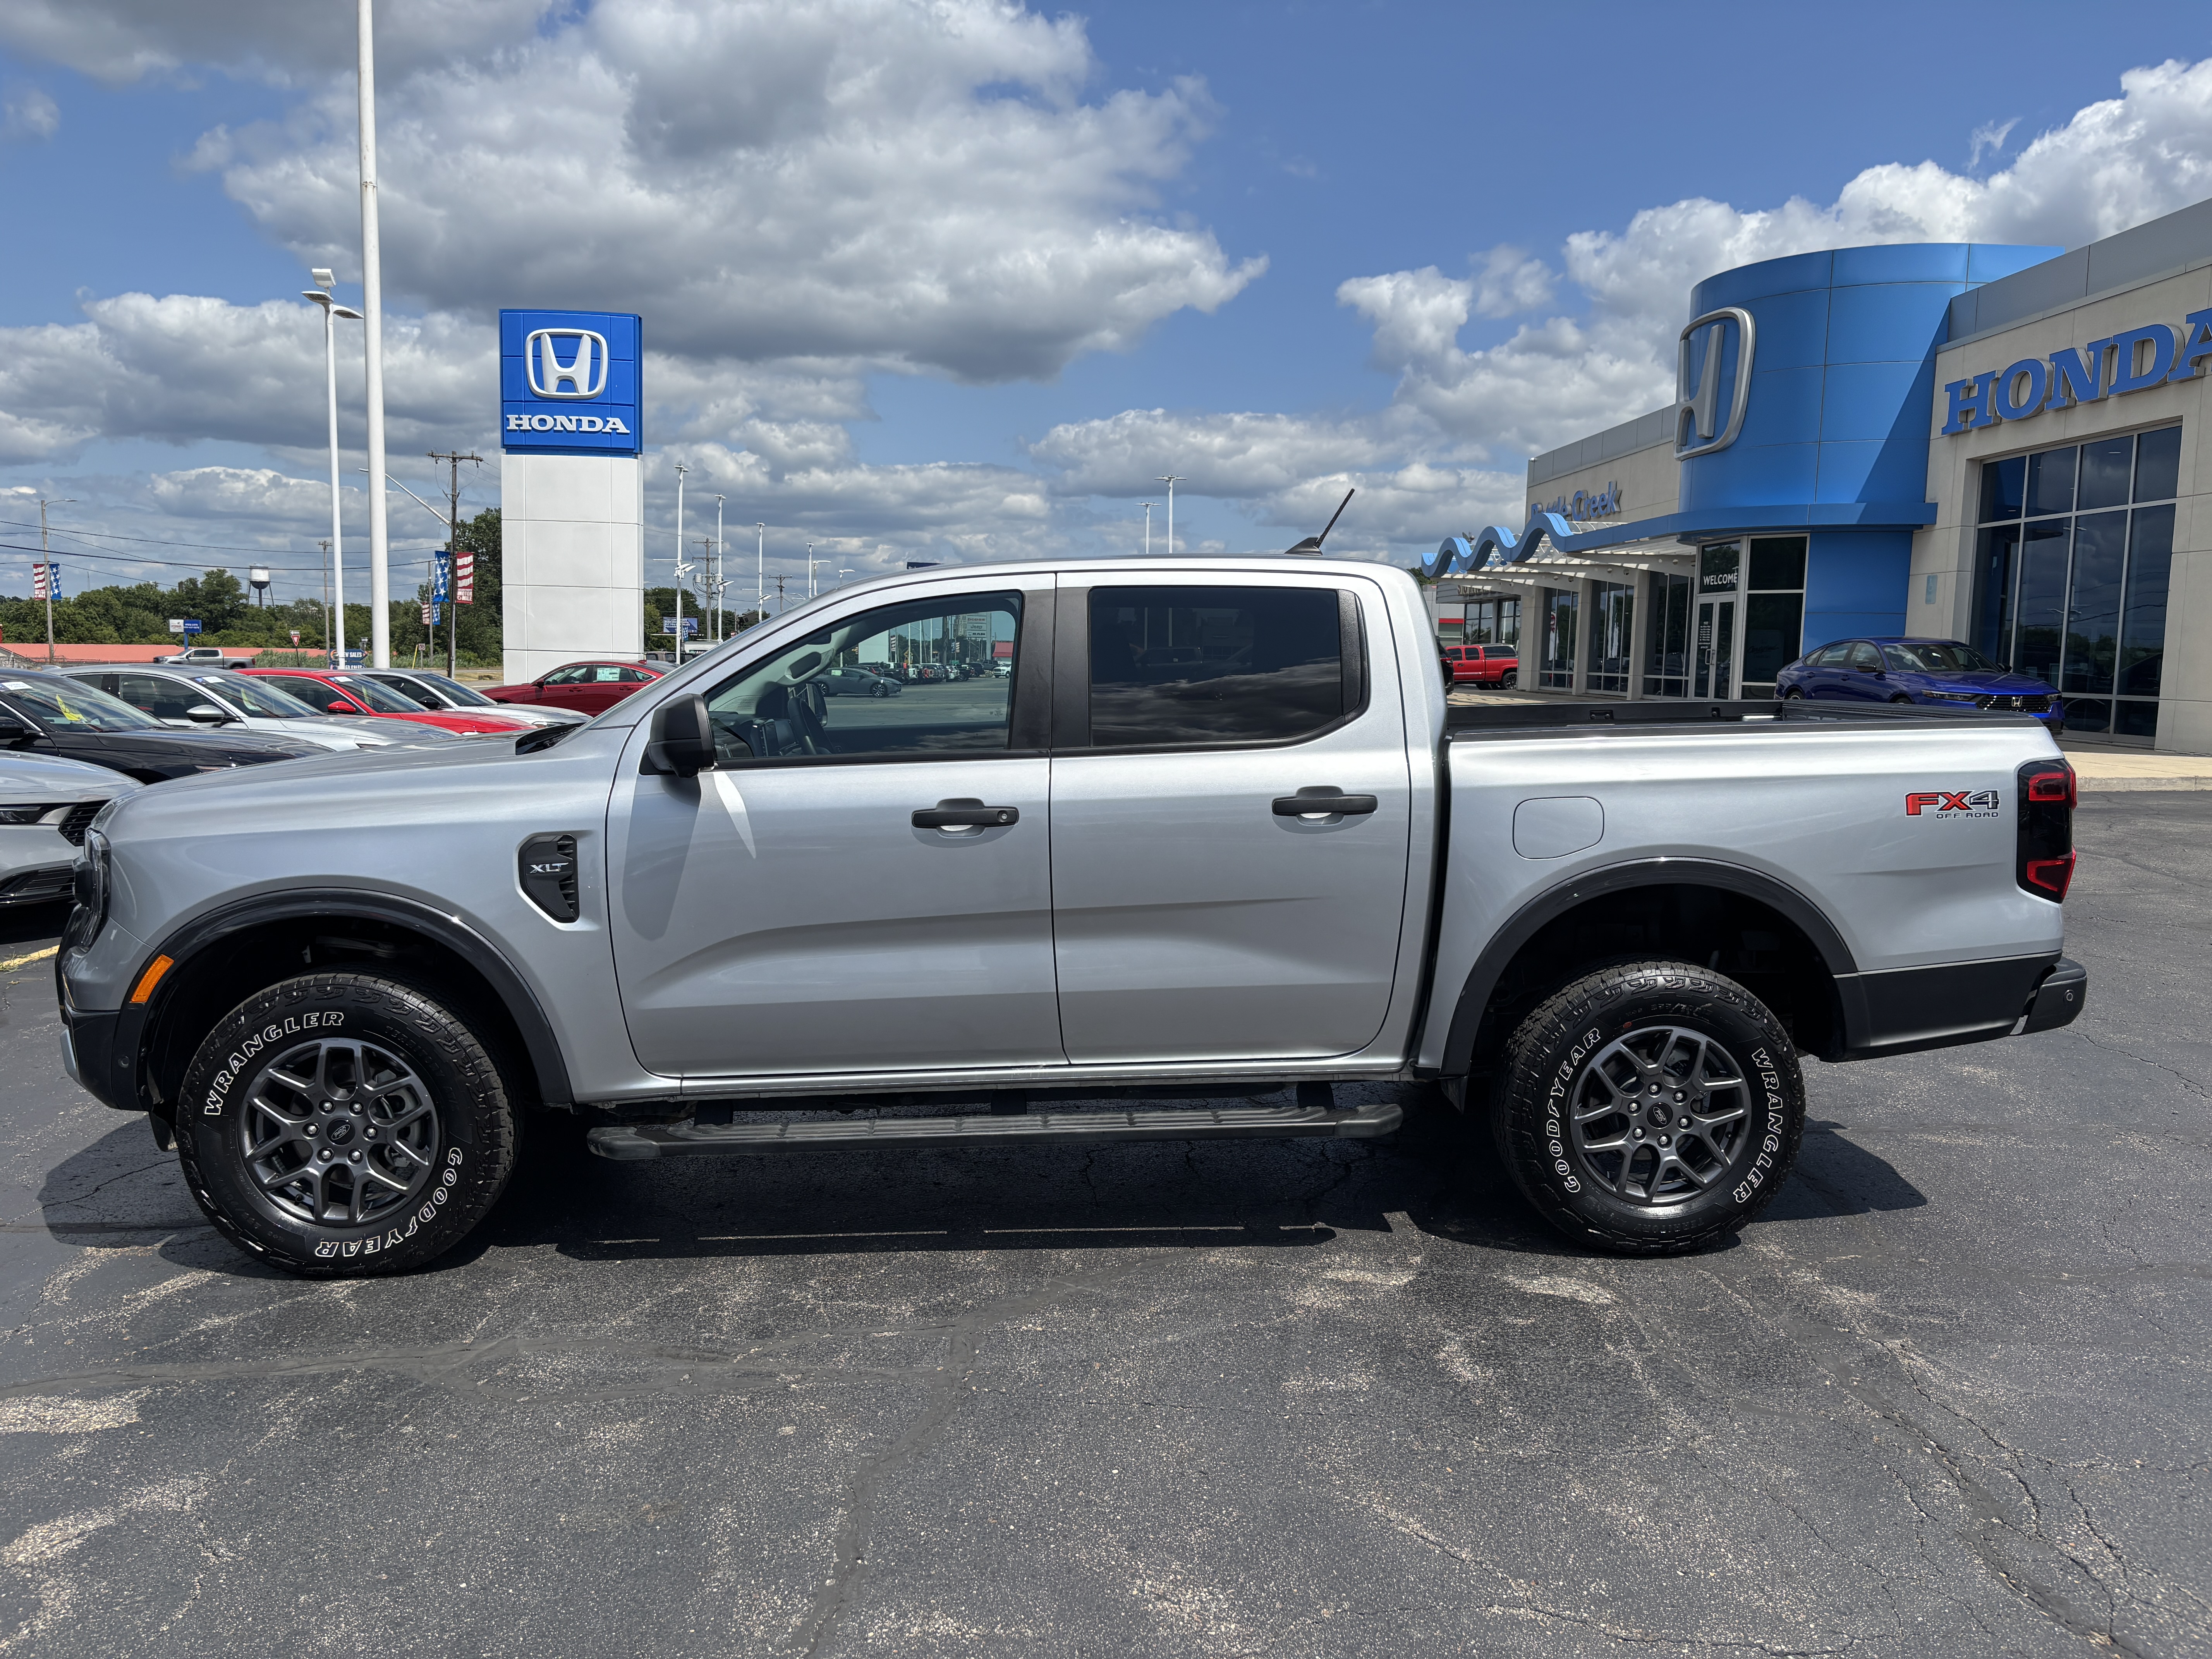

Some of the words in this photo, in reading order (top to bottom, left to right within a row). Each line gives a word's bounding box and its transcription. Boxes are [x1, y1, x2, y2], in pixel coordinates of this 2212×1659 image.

[506, 414, 630, 434] HONDA
[1572, 481, 1620, 522] Creek
[1703, 573, 1738, 586] WELCOME
[1905, 790, 1999, 816] FX4
[530, 862, 569, 874] XLT
[204, 1012, 344, 1116] WRANGLER
[1547, 1028, 1601, 1193] GOODYEAR
[1733, 1047, 1783, 1204] WRANGLER
[315, 1147, 462, 1257] GOODYEAR
